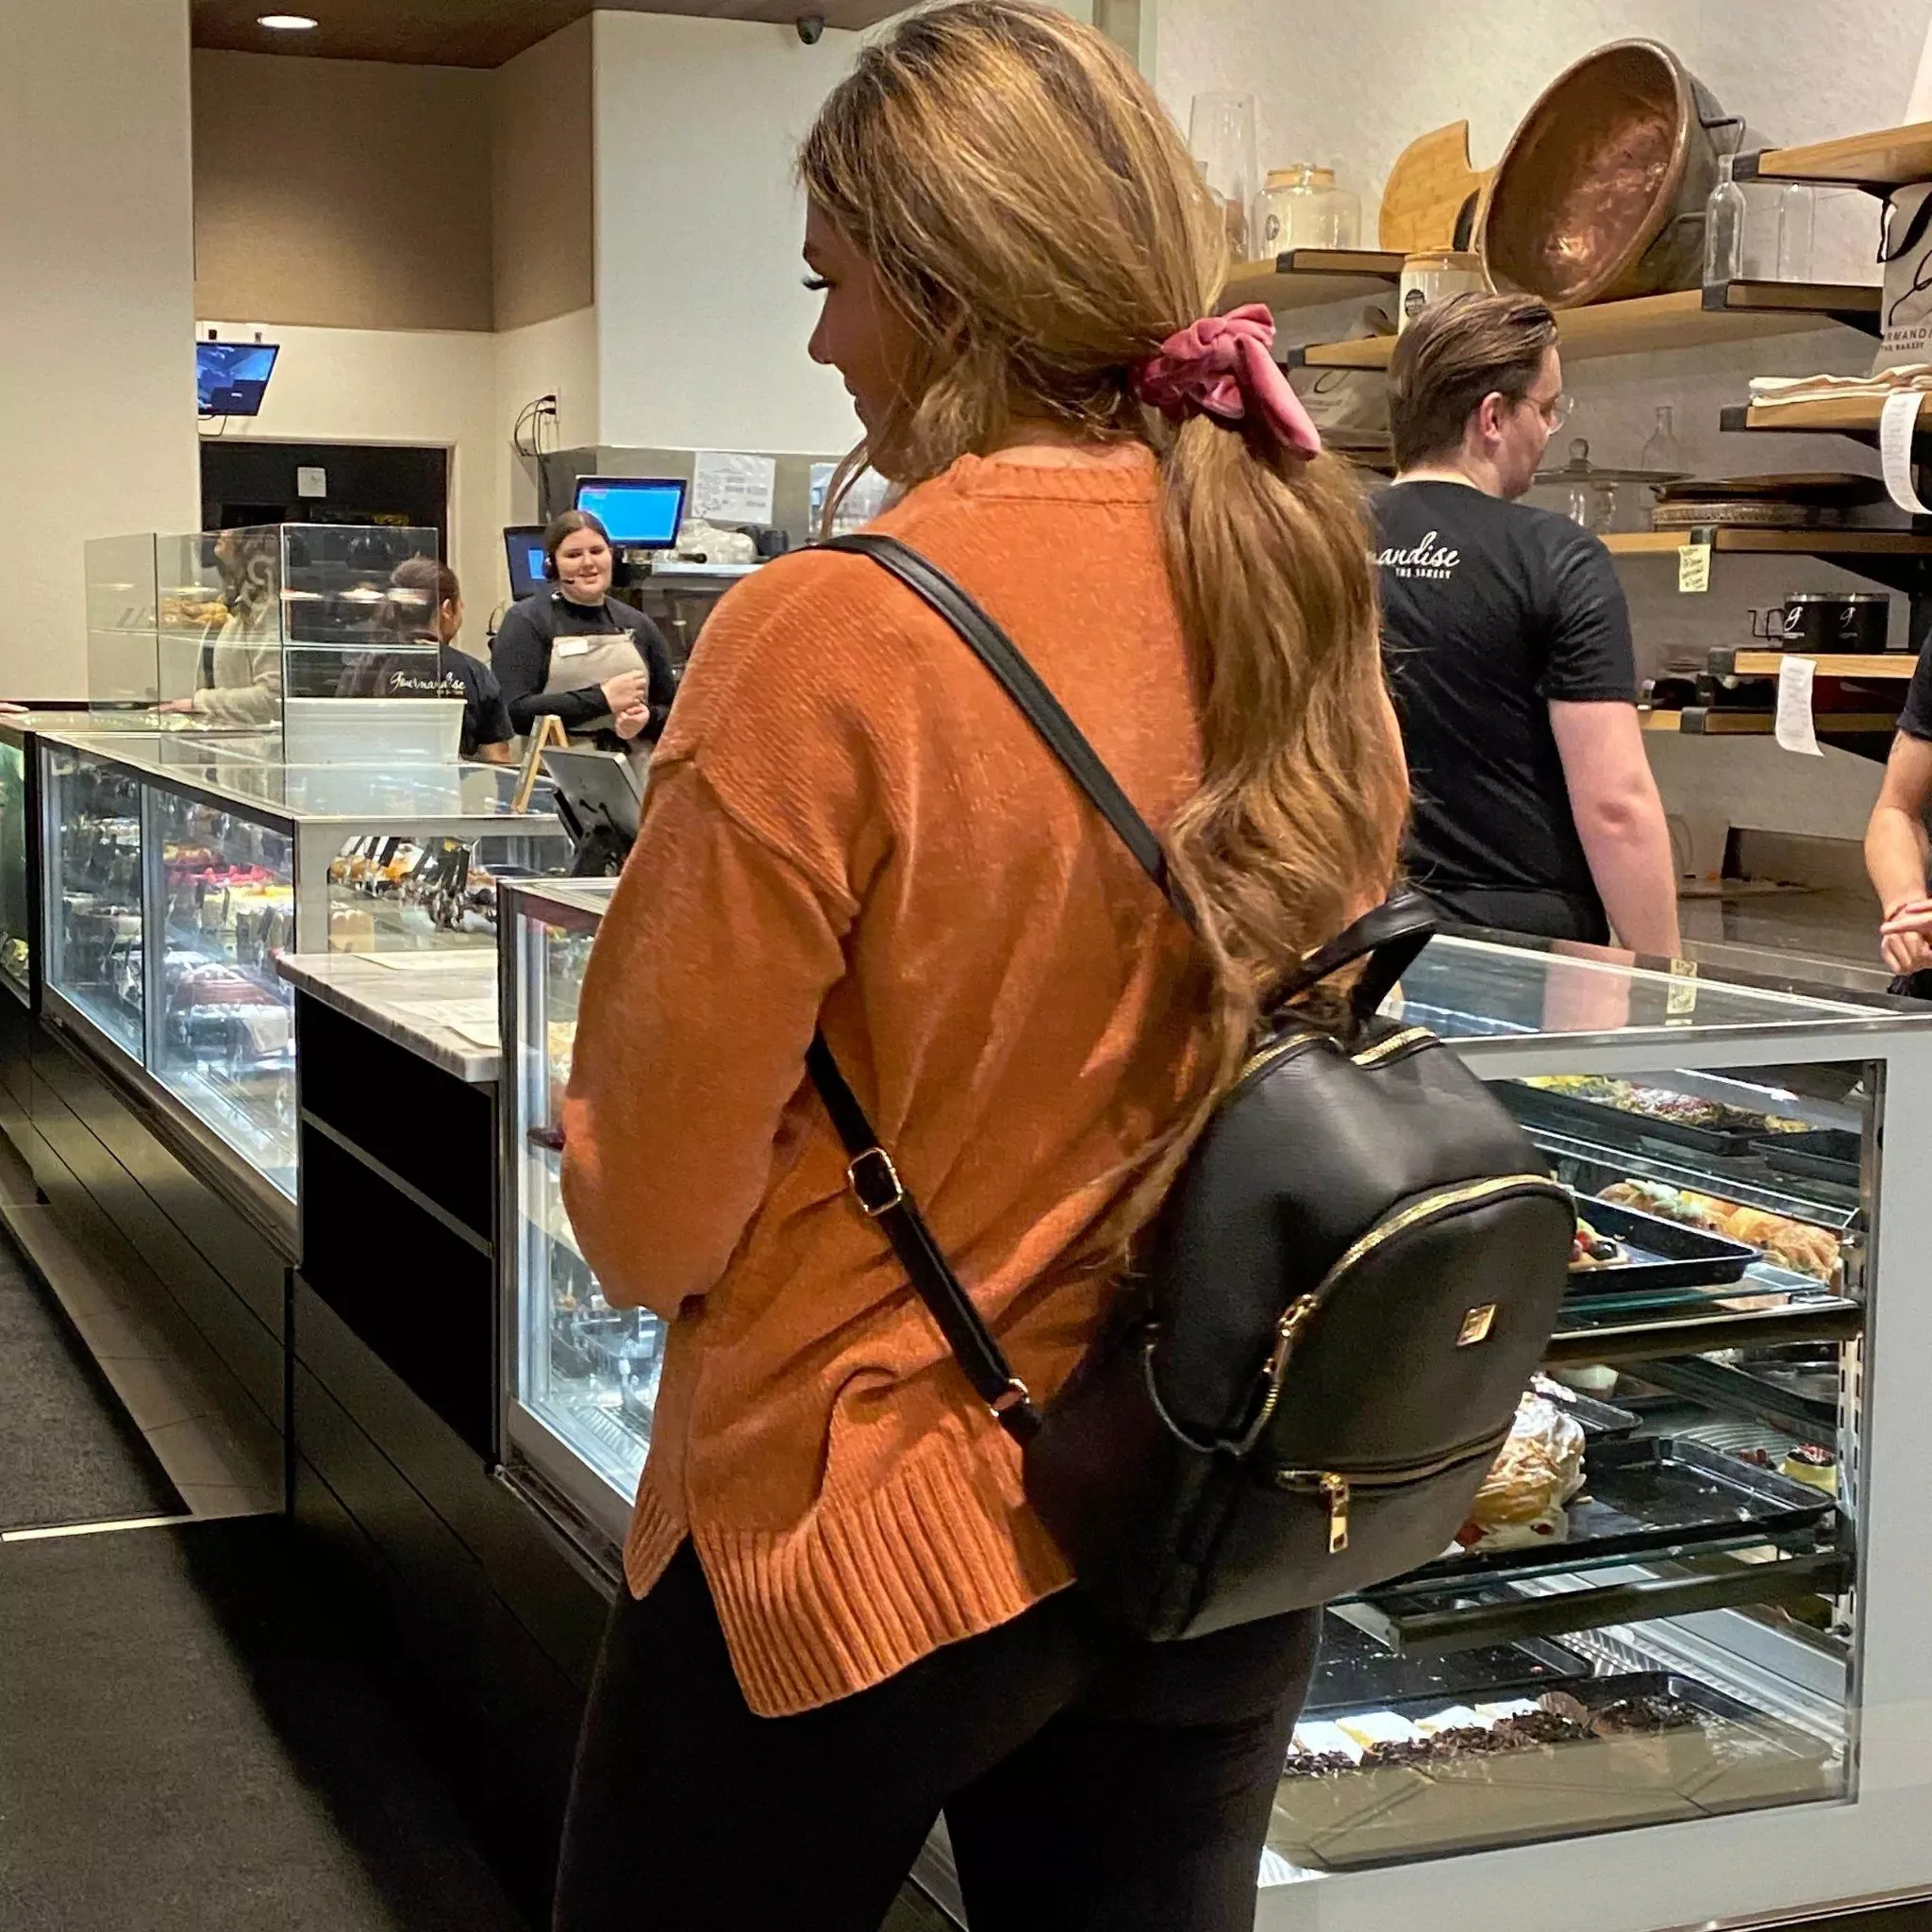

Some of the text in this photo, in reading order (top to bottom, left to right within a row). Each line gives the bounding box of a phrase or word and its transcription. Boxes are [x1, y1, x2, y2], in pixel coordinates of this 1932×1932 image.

[1895, 341, 1924, 350] BAKERY
[1395, 568, 1451, 579] THE BAKERY
